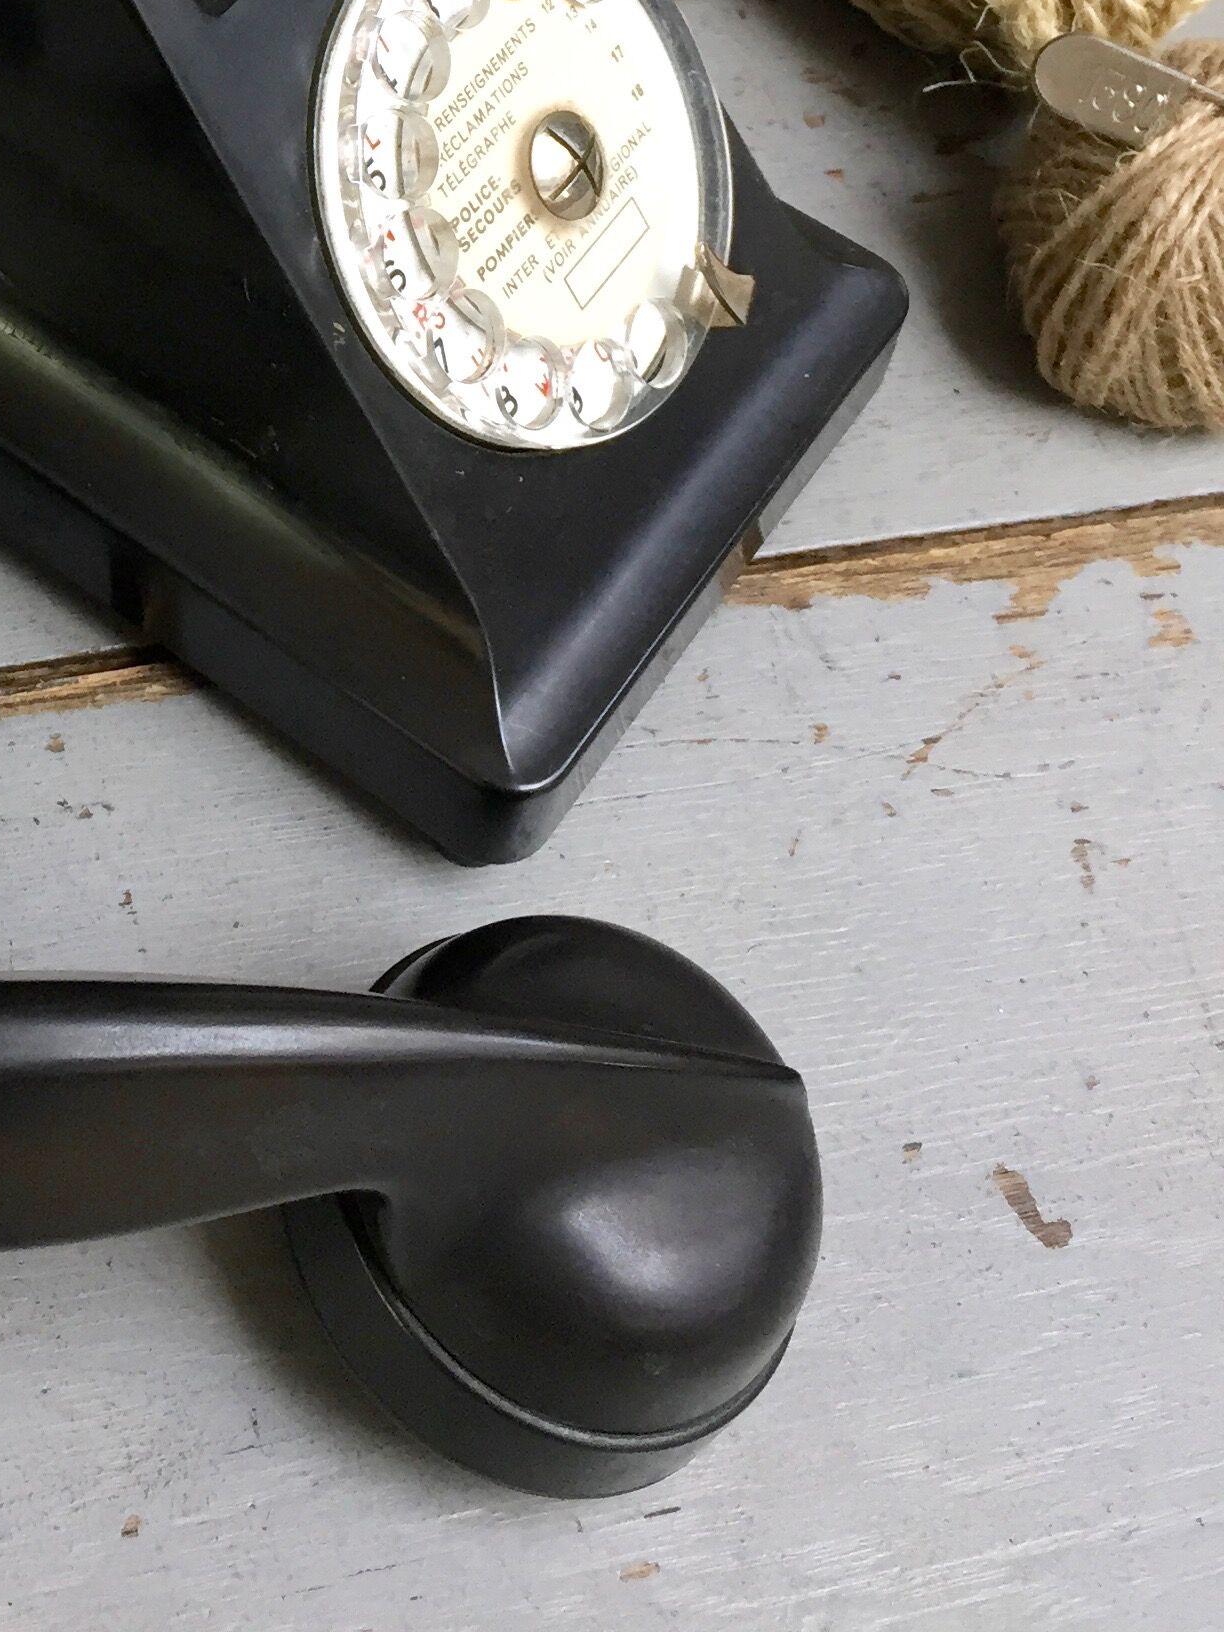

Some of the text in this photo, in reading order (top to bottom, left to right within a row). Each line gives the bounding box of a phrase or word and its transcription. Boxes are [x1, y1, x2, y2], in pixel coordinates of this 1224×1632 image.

[433, 17, 536, 133] RENSEIGNEMENTS
[611, 44, 624, 63] 17
[631, 83, 644, 101] 18
[437, 110, 516, 198] TÉLÉGRAPHE
[458, 178, 522, 254] SECOURS
[502, 254, 539, 300] INTER
[608, 121, 652, 179] GIONAL
[542, 239, 577, 284] (VOIR
